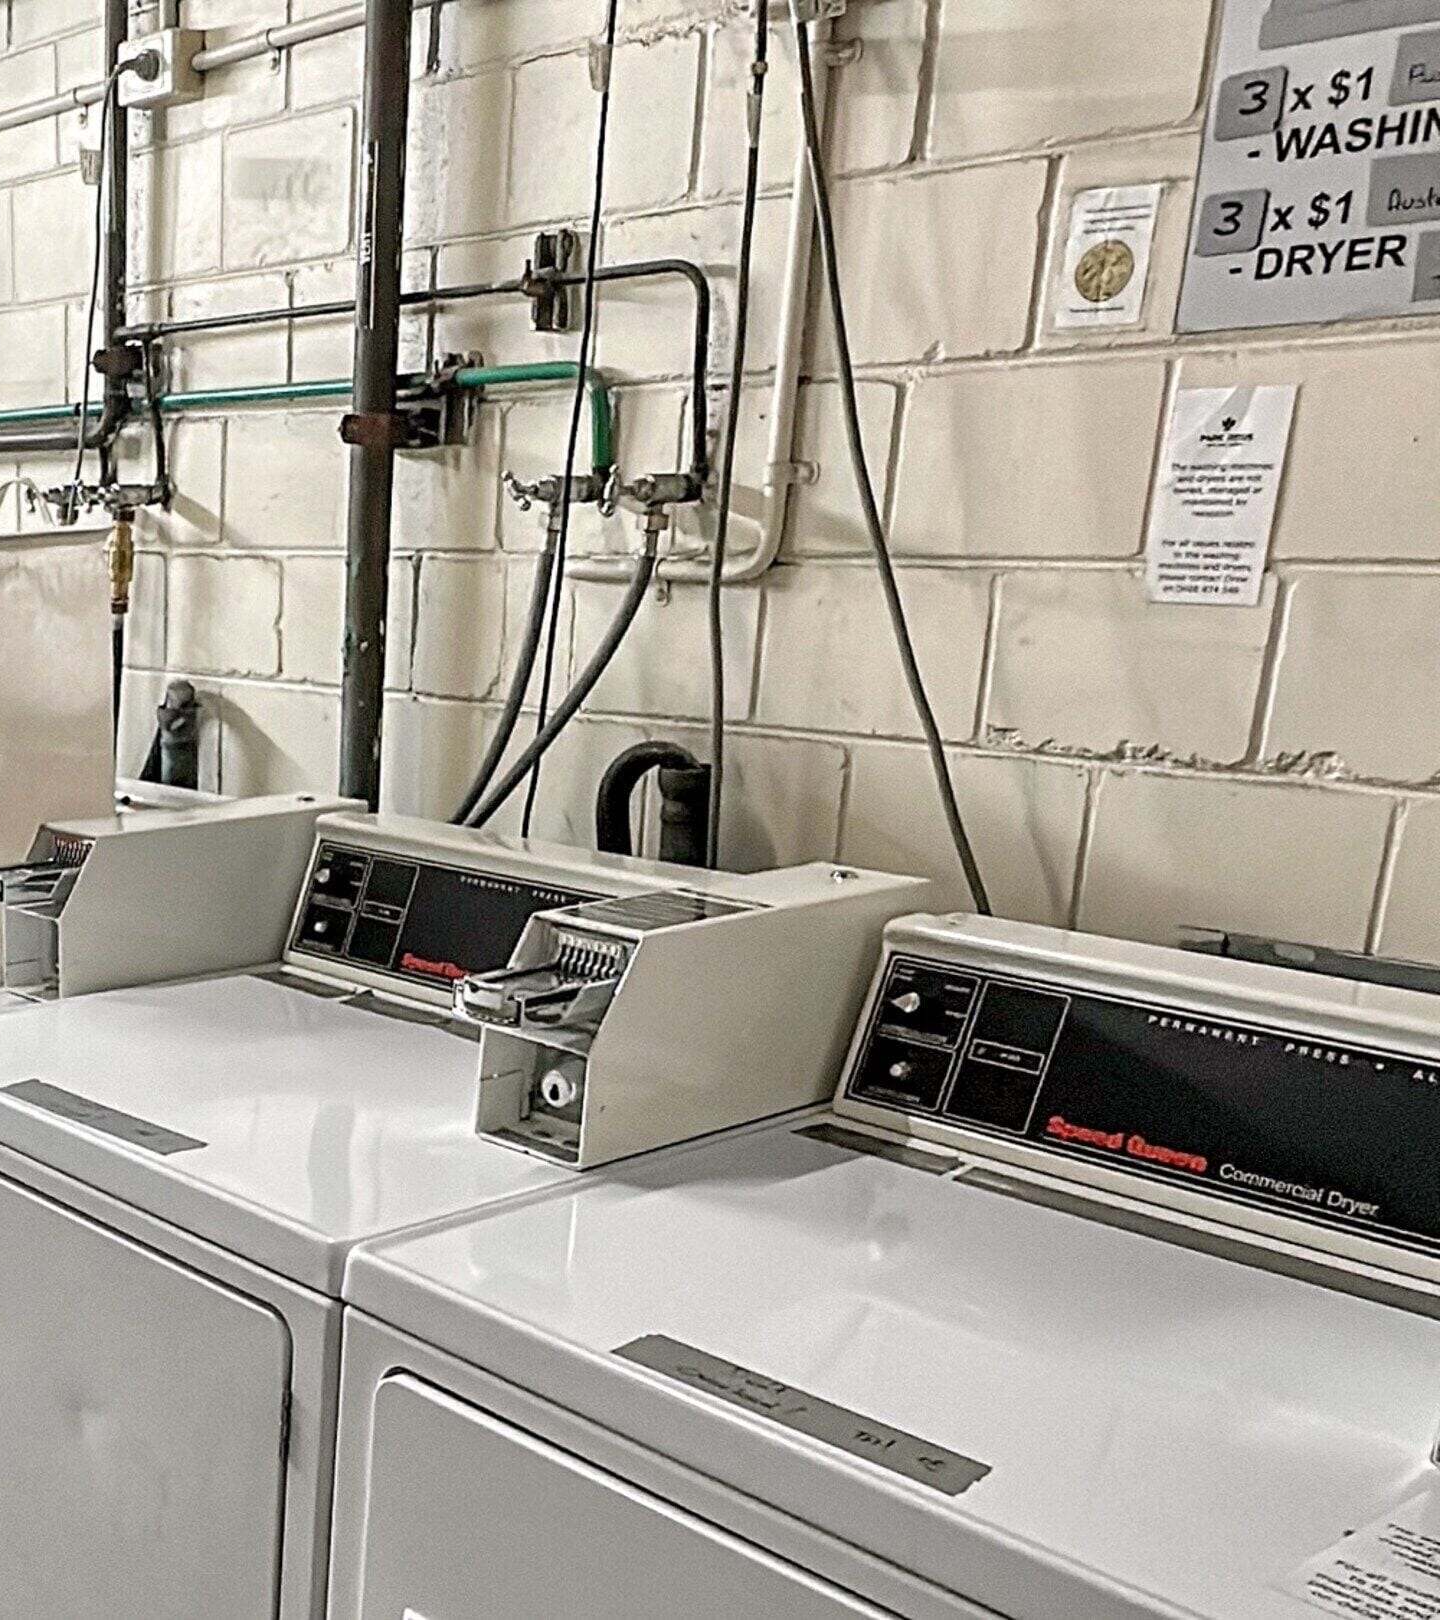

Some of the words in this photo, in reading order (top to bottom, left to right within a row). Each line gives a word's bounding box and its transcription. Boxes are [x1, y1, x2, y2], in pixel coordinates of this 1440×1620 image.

[1238, 80, 1270, 115] 3
[1289, 84, 1315, 112] x
[1326, 66, 1375, 108] $1
[1213, 201, 1244, 236] 3
[1269, 204, 1295, 232] x
[1307, 190, 1354, 229] $1
[1254, 234, 1408, 281] DRYER
[1148, 1014, 1260, 1045] PERMANENT
[1285, 1043, 1350, 1065] PRESS
[1046, 1115, 1125, 1149] Speed
[1127, 1134, 1208, 1172] Queen
[1219, 1163, 1323, 1203] Commercial
[1327, 1191, 1381, 1217] Dryer
